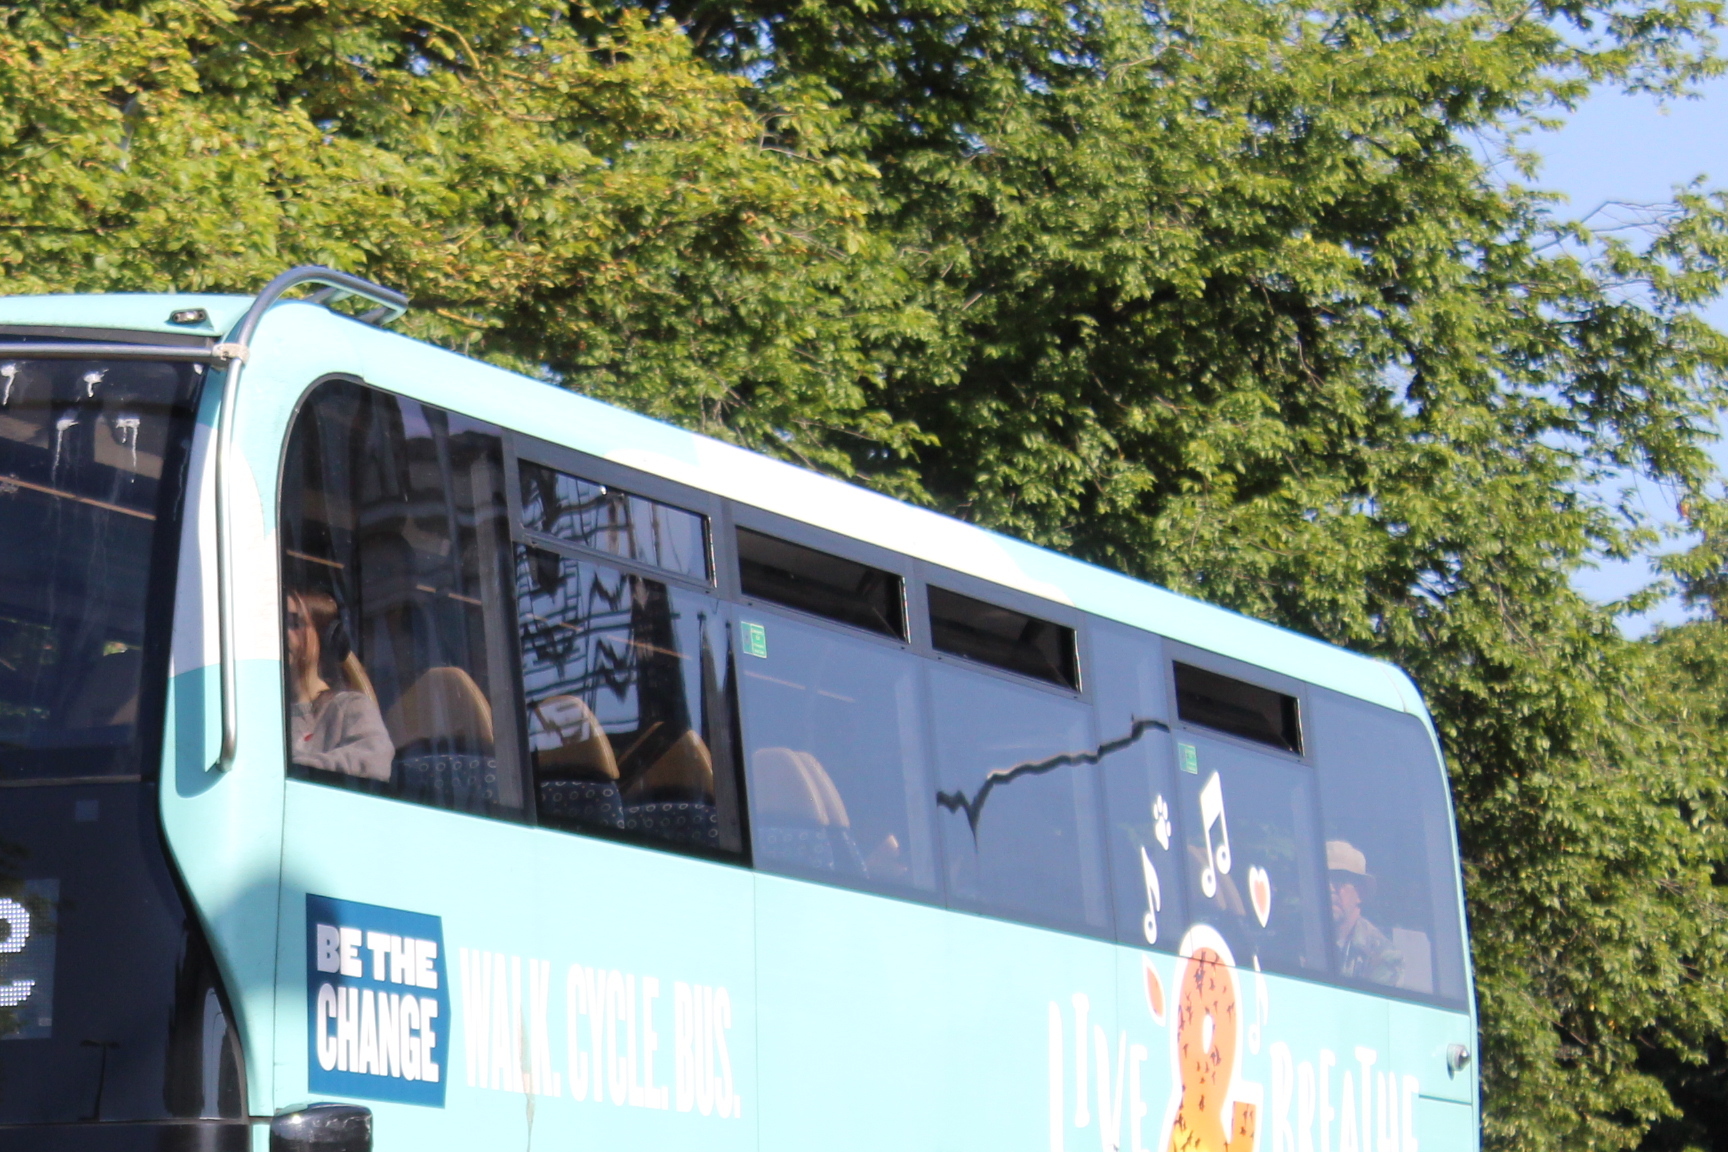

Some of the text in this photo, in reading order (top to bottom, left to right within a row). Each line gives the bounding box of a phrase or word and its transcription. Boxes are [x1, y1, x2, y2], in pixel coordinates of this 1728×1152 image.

[316, 923, 438, 990] BE THE
[316, 981, 440, 1084] CHANGE
